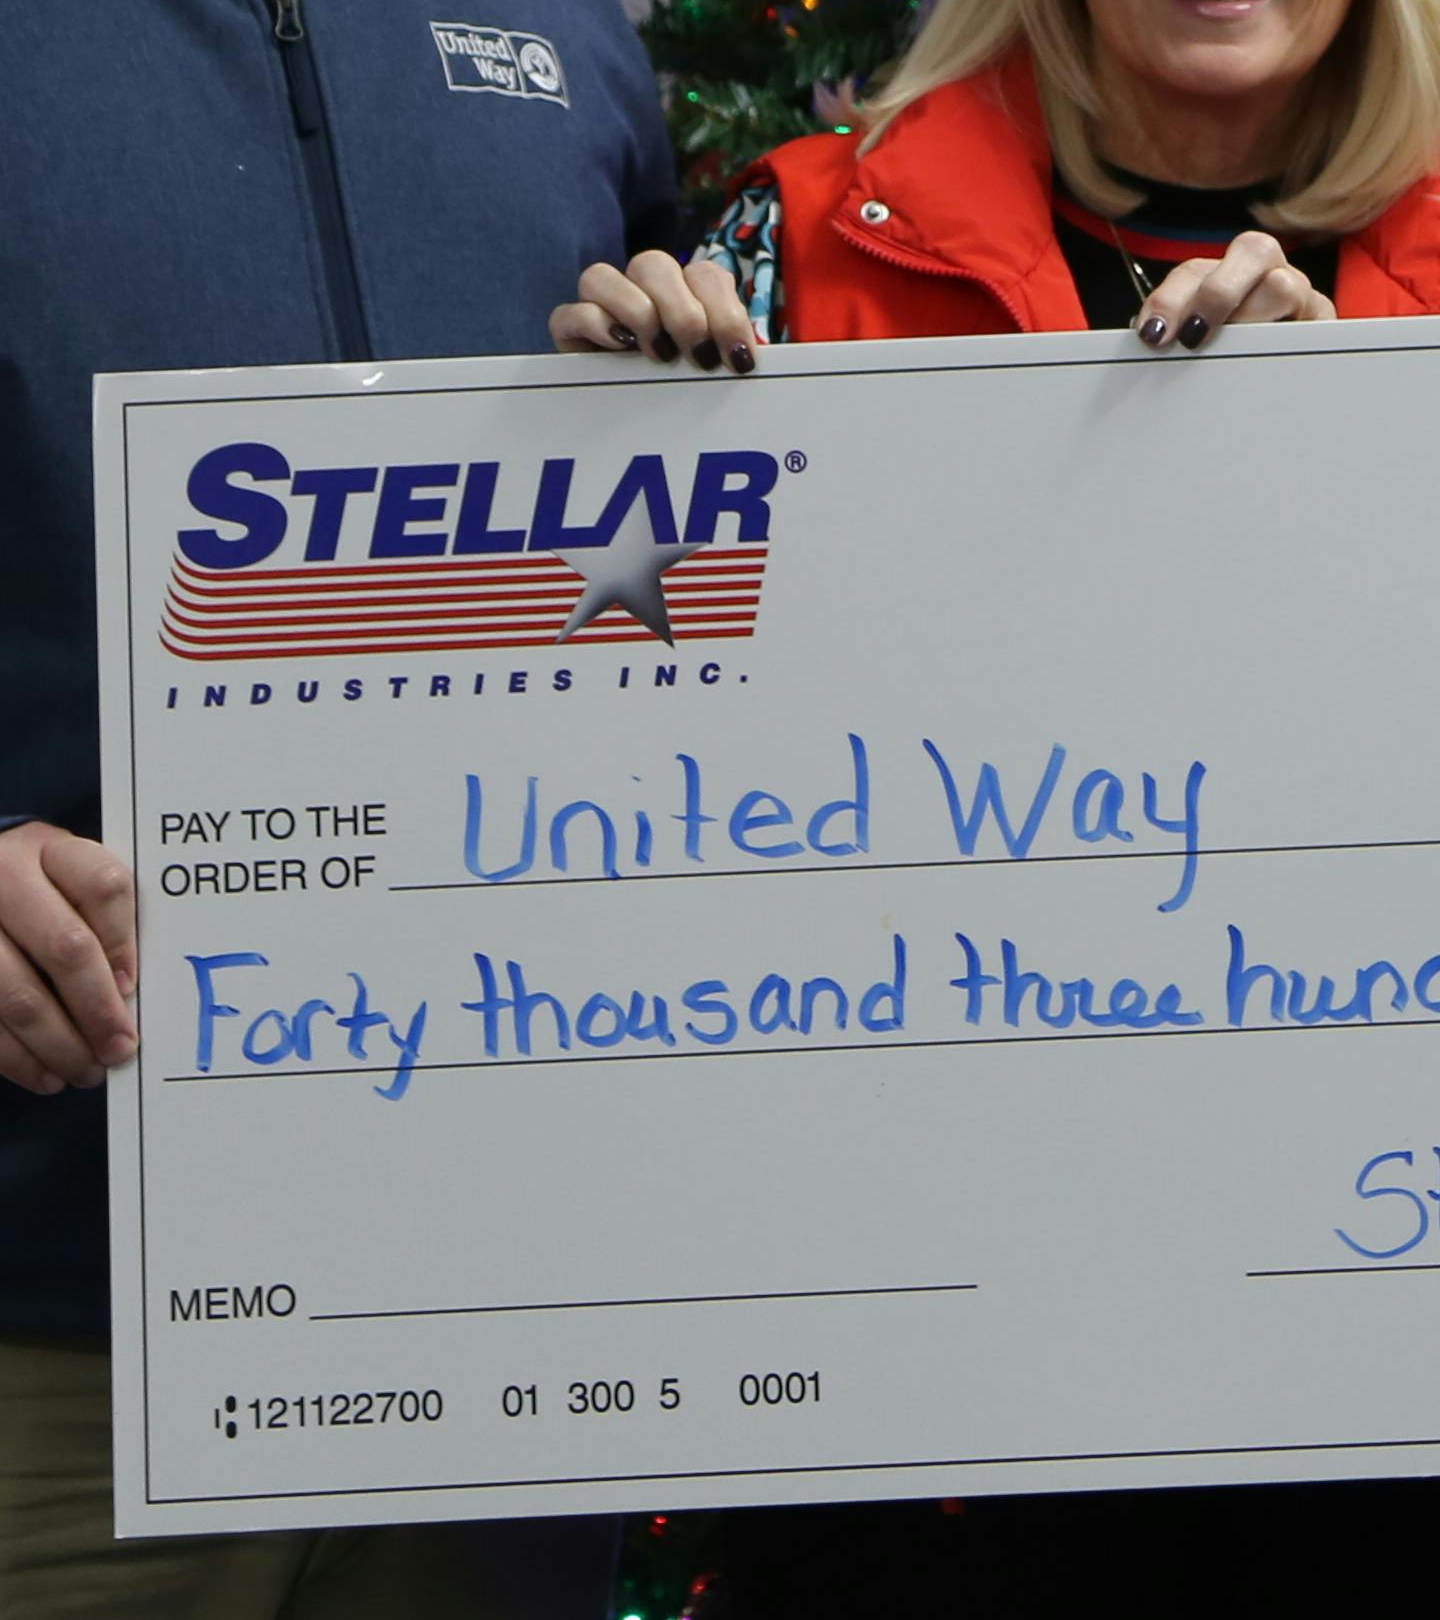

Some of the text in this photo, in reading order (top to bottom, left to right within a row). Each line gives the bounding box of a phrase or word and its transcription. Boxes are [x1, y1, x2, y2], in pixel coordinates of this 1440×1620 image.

[436, 31, 512, 62] United
[472, 57, 517, 90] Way
[166, 662, 748, 708] INDUSTRIES INC.
[161, 804, 389, 846] PAY TO THE
[464, 732, 1210, 915] United Way
[160, 855, 377, 898] ORDER OF
[185, 951, 431, 1102] Forty
[461, 933, 910, 1060] thousand
[948, 932, 1208, 1036] three
[170, 1284, 298, 1323] MEMO
[247, 1371, 822, 1431] 121122700 01 300 5 0001
